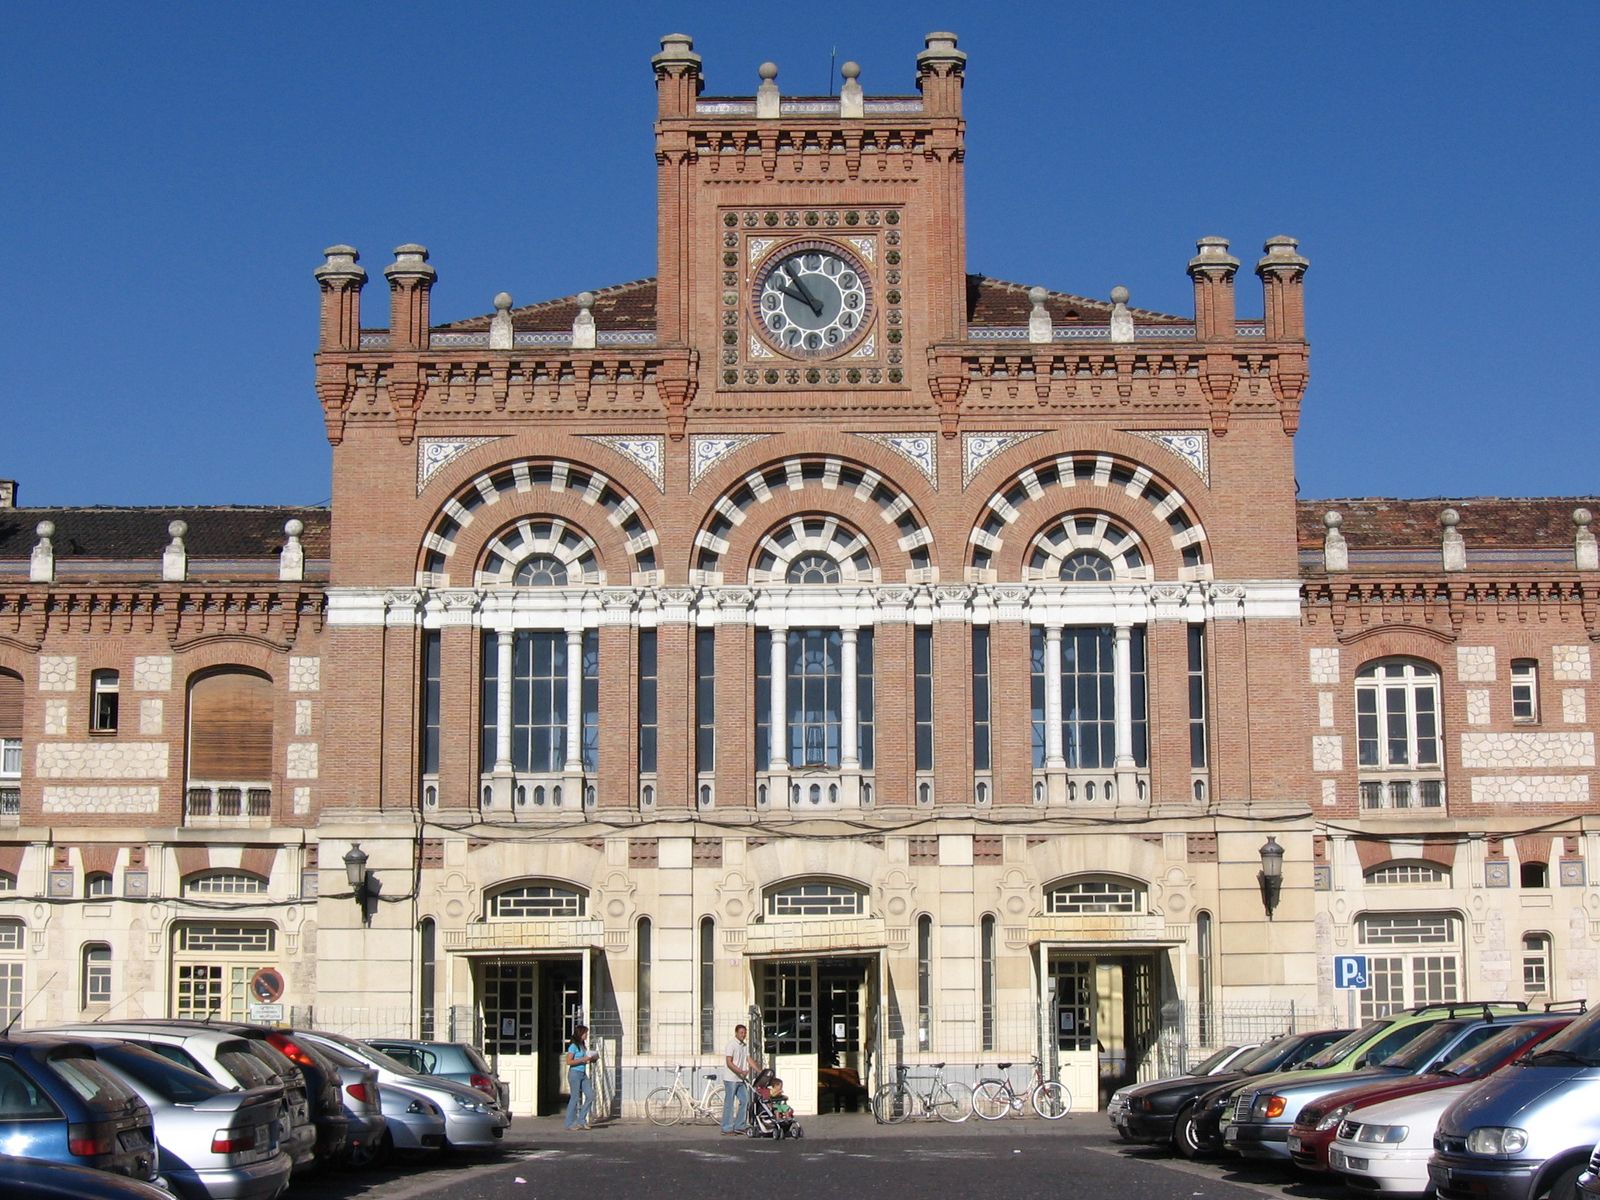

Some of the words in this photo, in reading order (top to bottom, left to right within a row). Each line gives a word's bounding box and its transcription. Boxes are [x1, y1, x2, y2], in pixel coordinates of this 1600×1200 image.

[844, 274, 853, 289] 2
[767, 295, 776, 310] 9
[849, 293, 858, 309] 3
[773, 314, 781, 329] 8
[843, 313, 853, 328] 4
[788, 330, 797, 345] 7
[808, 334, 817, 349] 6
[829, 328, 838, 343] 5
[1342, 958, 1358, 987] P
